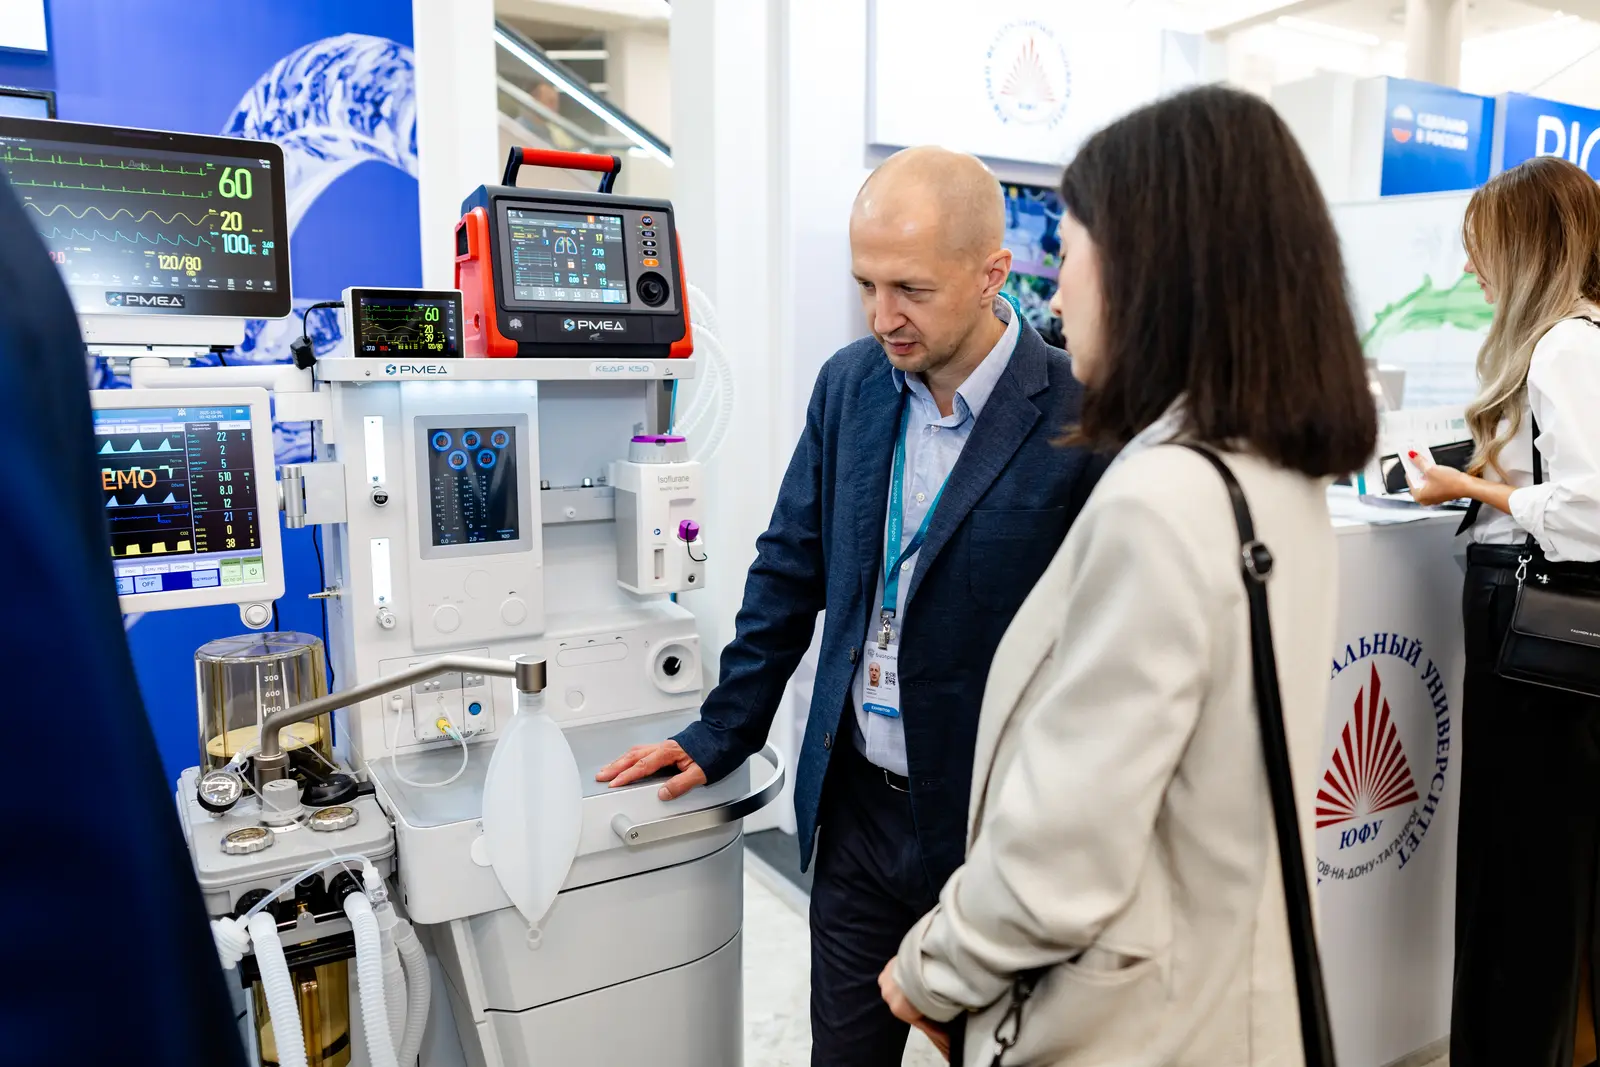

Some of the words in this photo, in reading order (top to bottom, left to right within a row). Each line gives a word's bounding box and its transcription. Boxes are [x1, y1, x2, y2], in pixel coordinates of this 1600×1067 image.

[218, 167, 253, 199] 60
[220, 211, 243, 231] 20
[221, 233, 250, 254] 100
[158, 254, 202, 271] 120/80
[424, 307, 439, 322] 60
[424, 324, 434, 333] 20
[425, 333, 434, 343] 39
[216, 431, 227, 441] 22
[220, 445, 226, 454] 2
[221, 458, 227, 468] 5
[218, 472, 232, 481] 510
[657, 474, 690, 484] Isoflurane
[219, 485, 233, 495] 8.0
[223, 498, 232, 508] 12
[224, 511, 233, 521] 21
[226, 525, 232, 534] 0
[226, 538, 236, 548] 38
[266, 705, 281, 713] 900
[1397, 658, 1451, 871] УНИВЕРСИТЕТ
[1338, 819, 1385, 850] ЮФУ
